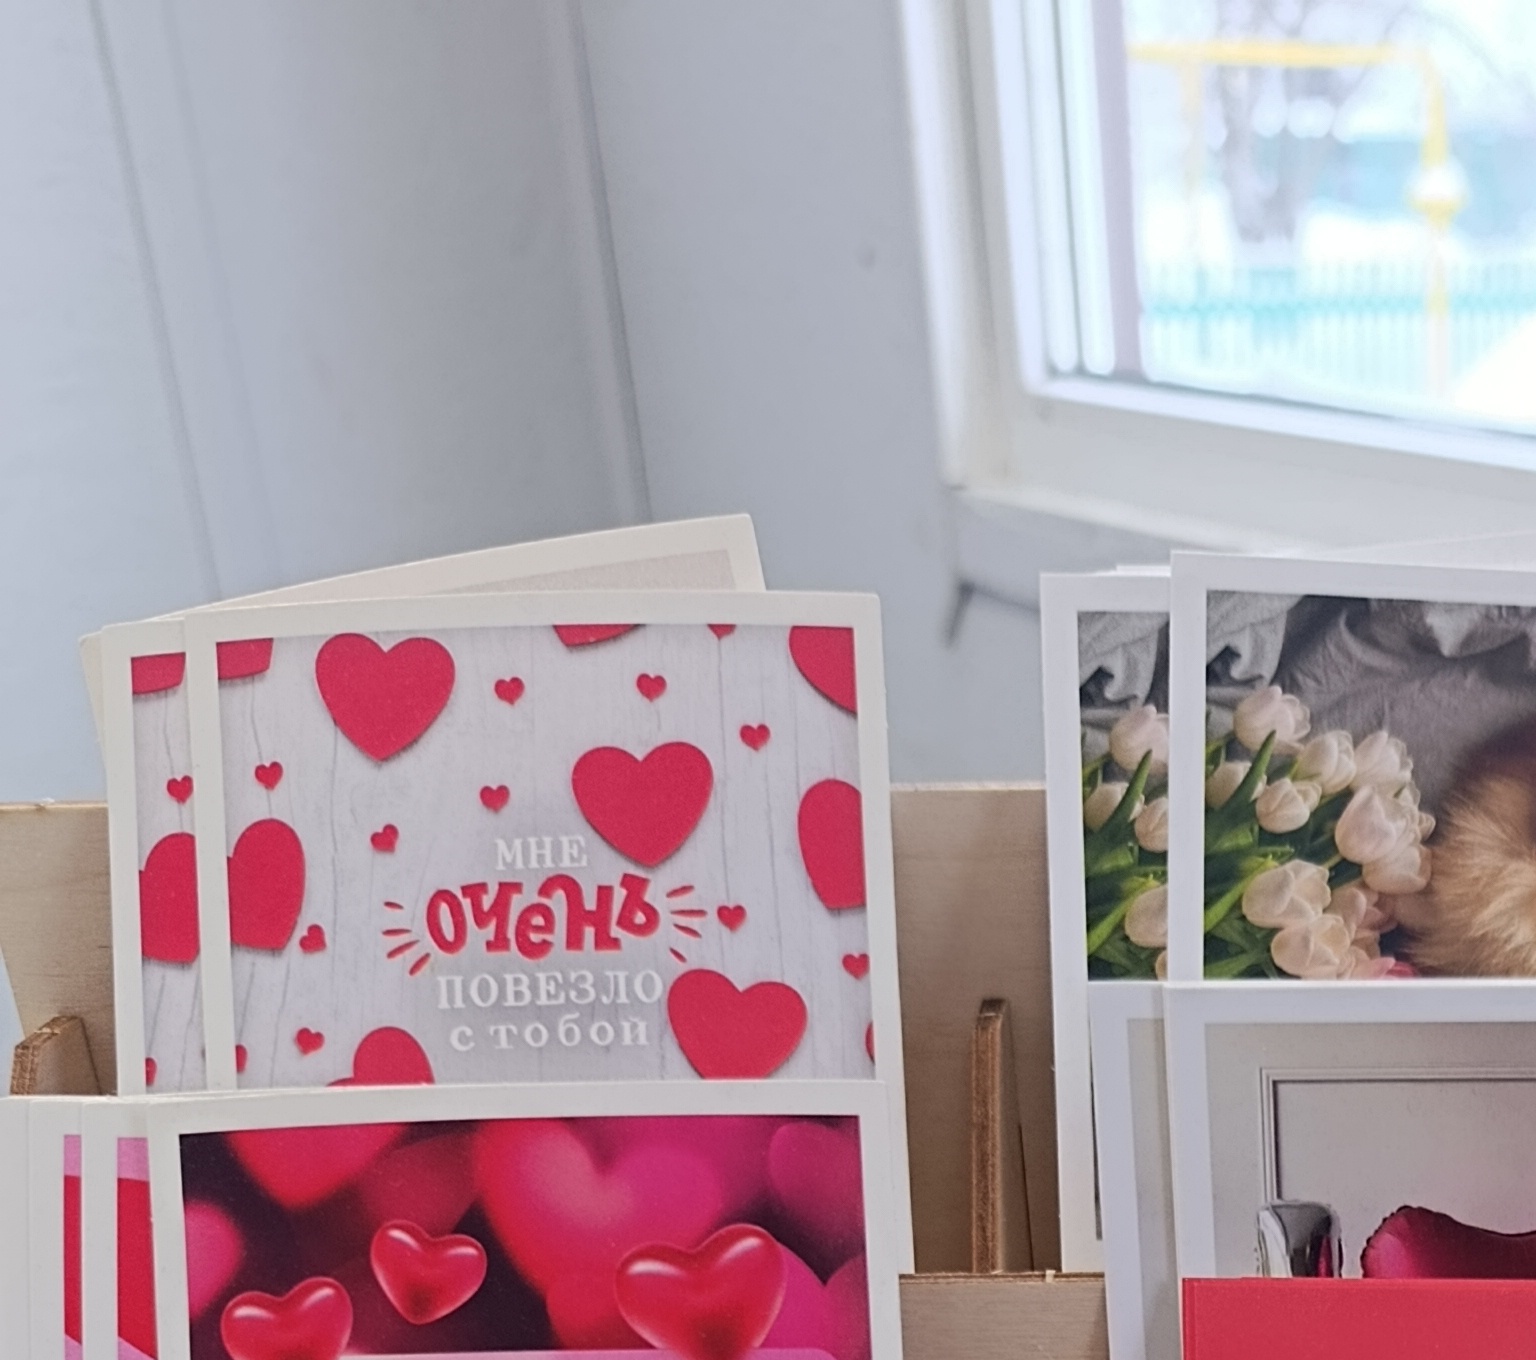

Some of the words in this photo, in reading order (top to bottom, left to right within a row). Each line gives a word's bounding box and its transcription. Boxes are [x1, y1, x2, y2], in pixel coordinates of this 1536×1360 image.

[495, 835, 588, 871] МНЕ
[436, 969, 664, 1010] ПОВЕЗЛО
[450, 1025, 476, 1051] с
[489, 1012, 650, 1050] тобой
